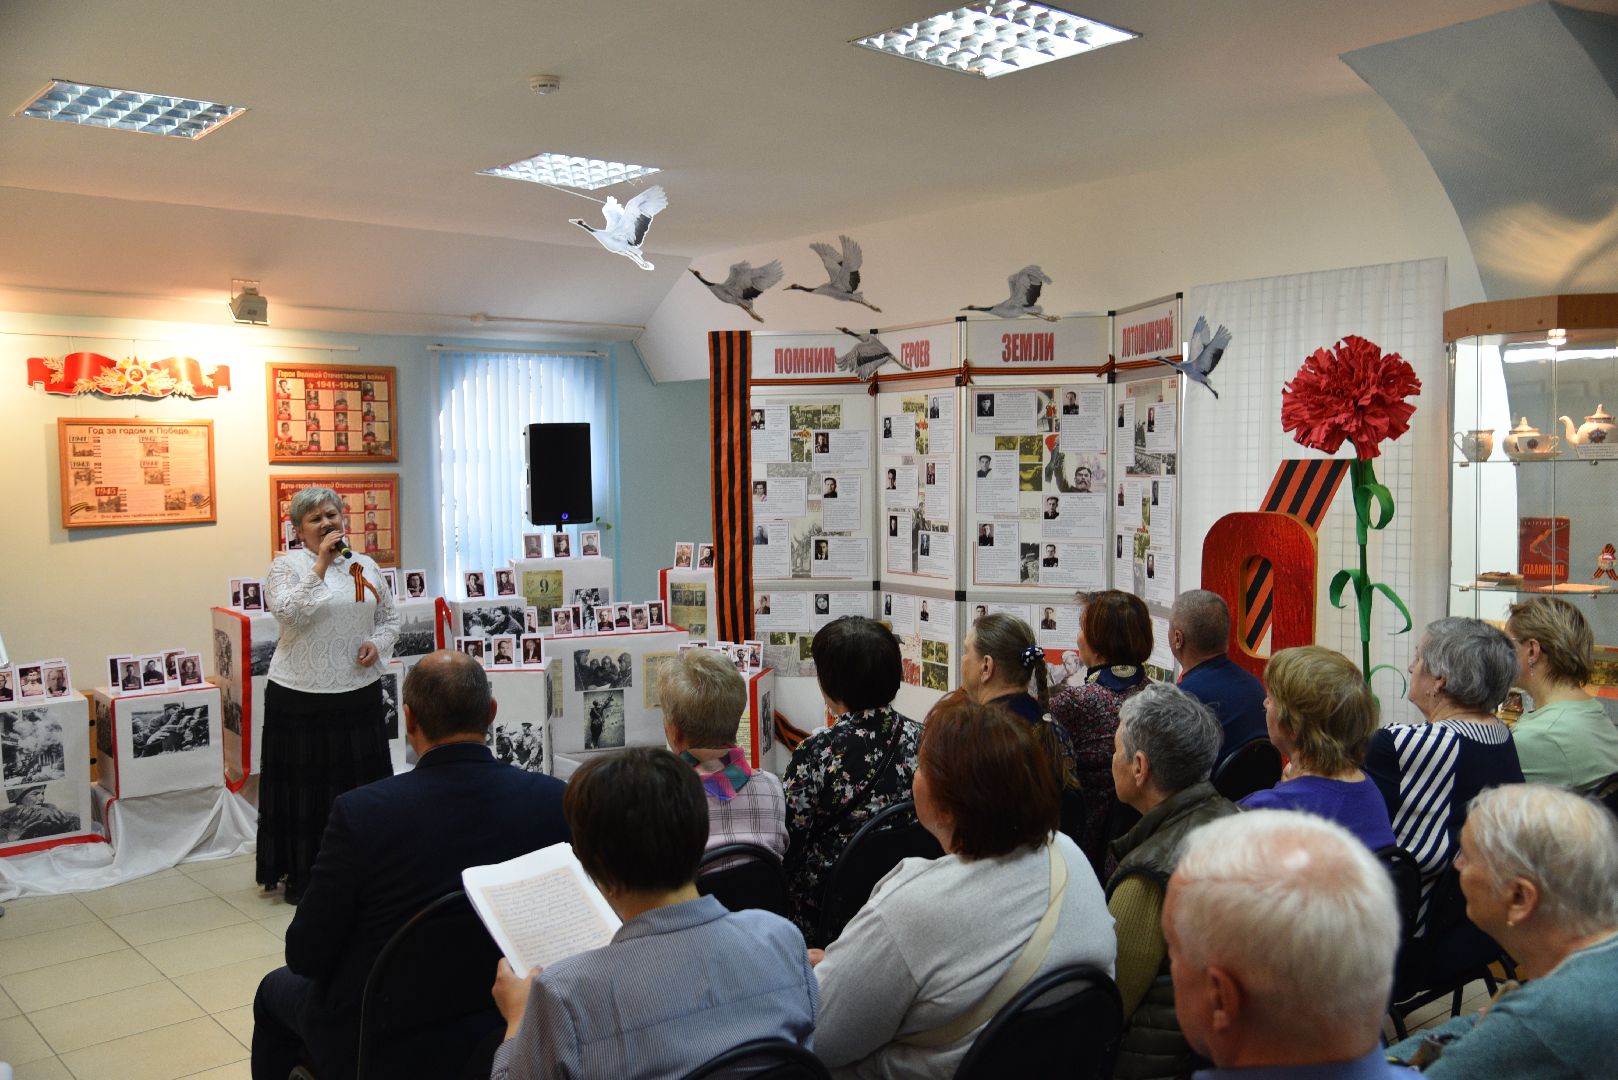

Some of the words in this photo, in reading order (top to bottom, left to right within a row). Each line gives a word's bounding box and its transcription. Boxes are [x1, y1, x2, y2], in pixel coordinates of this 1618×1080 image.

[774, 347, 836, 374] ПОМНИМ
[901, 340, 930, 368] ГЕРОЕВ
[1001, 332, 1054, 362] ЗЕМЛИ
[1122, 309, 1174, 358] ЛОТОШИНСКОЙ
[88, 426, 104, 435] Год
[119, 428, 146, 436] годом
[156, 427, 190, 436] Победе
[96, 487, 117, 495] 1945
[1523, 563, 1565, 577] СТАЛИНГАД
[540, 579, 549, 594] 9
